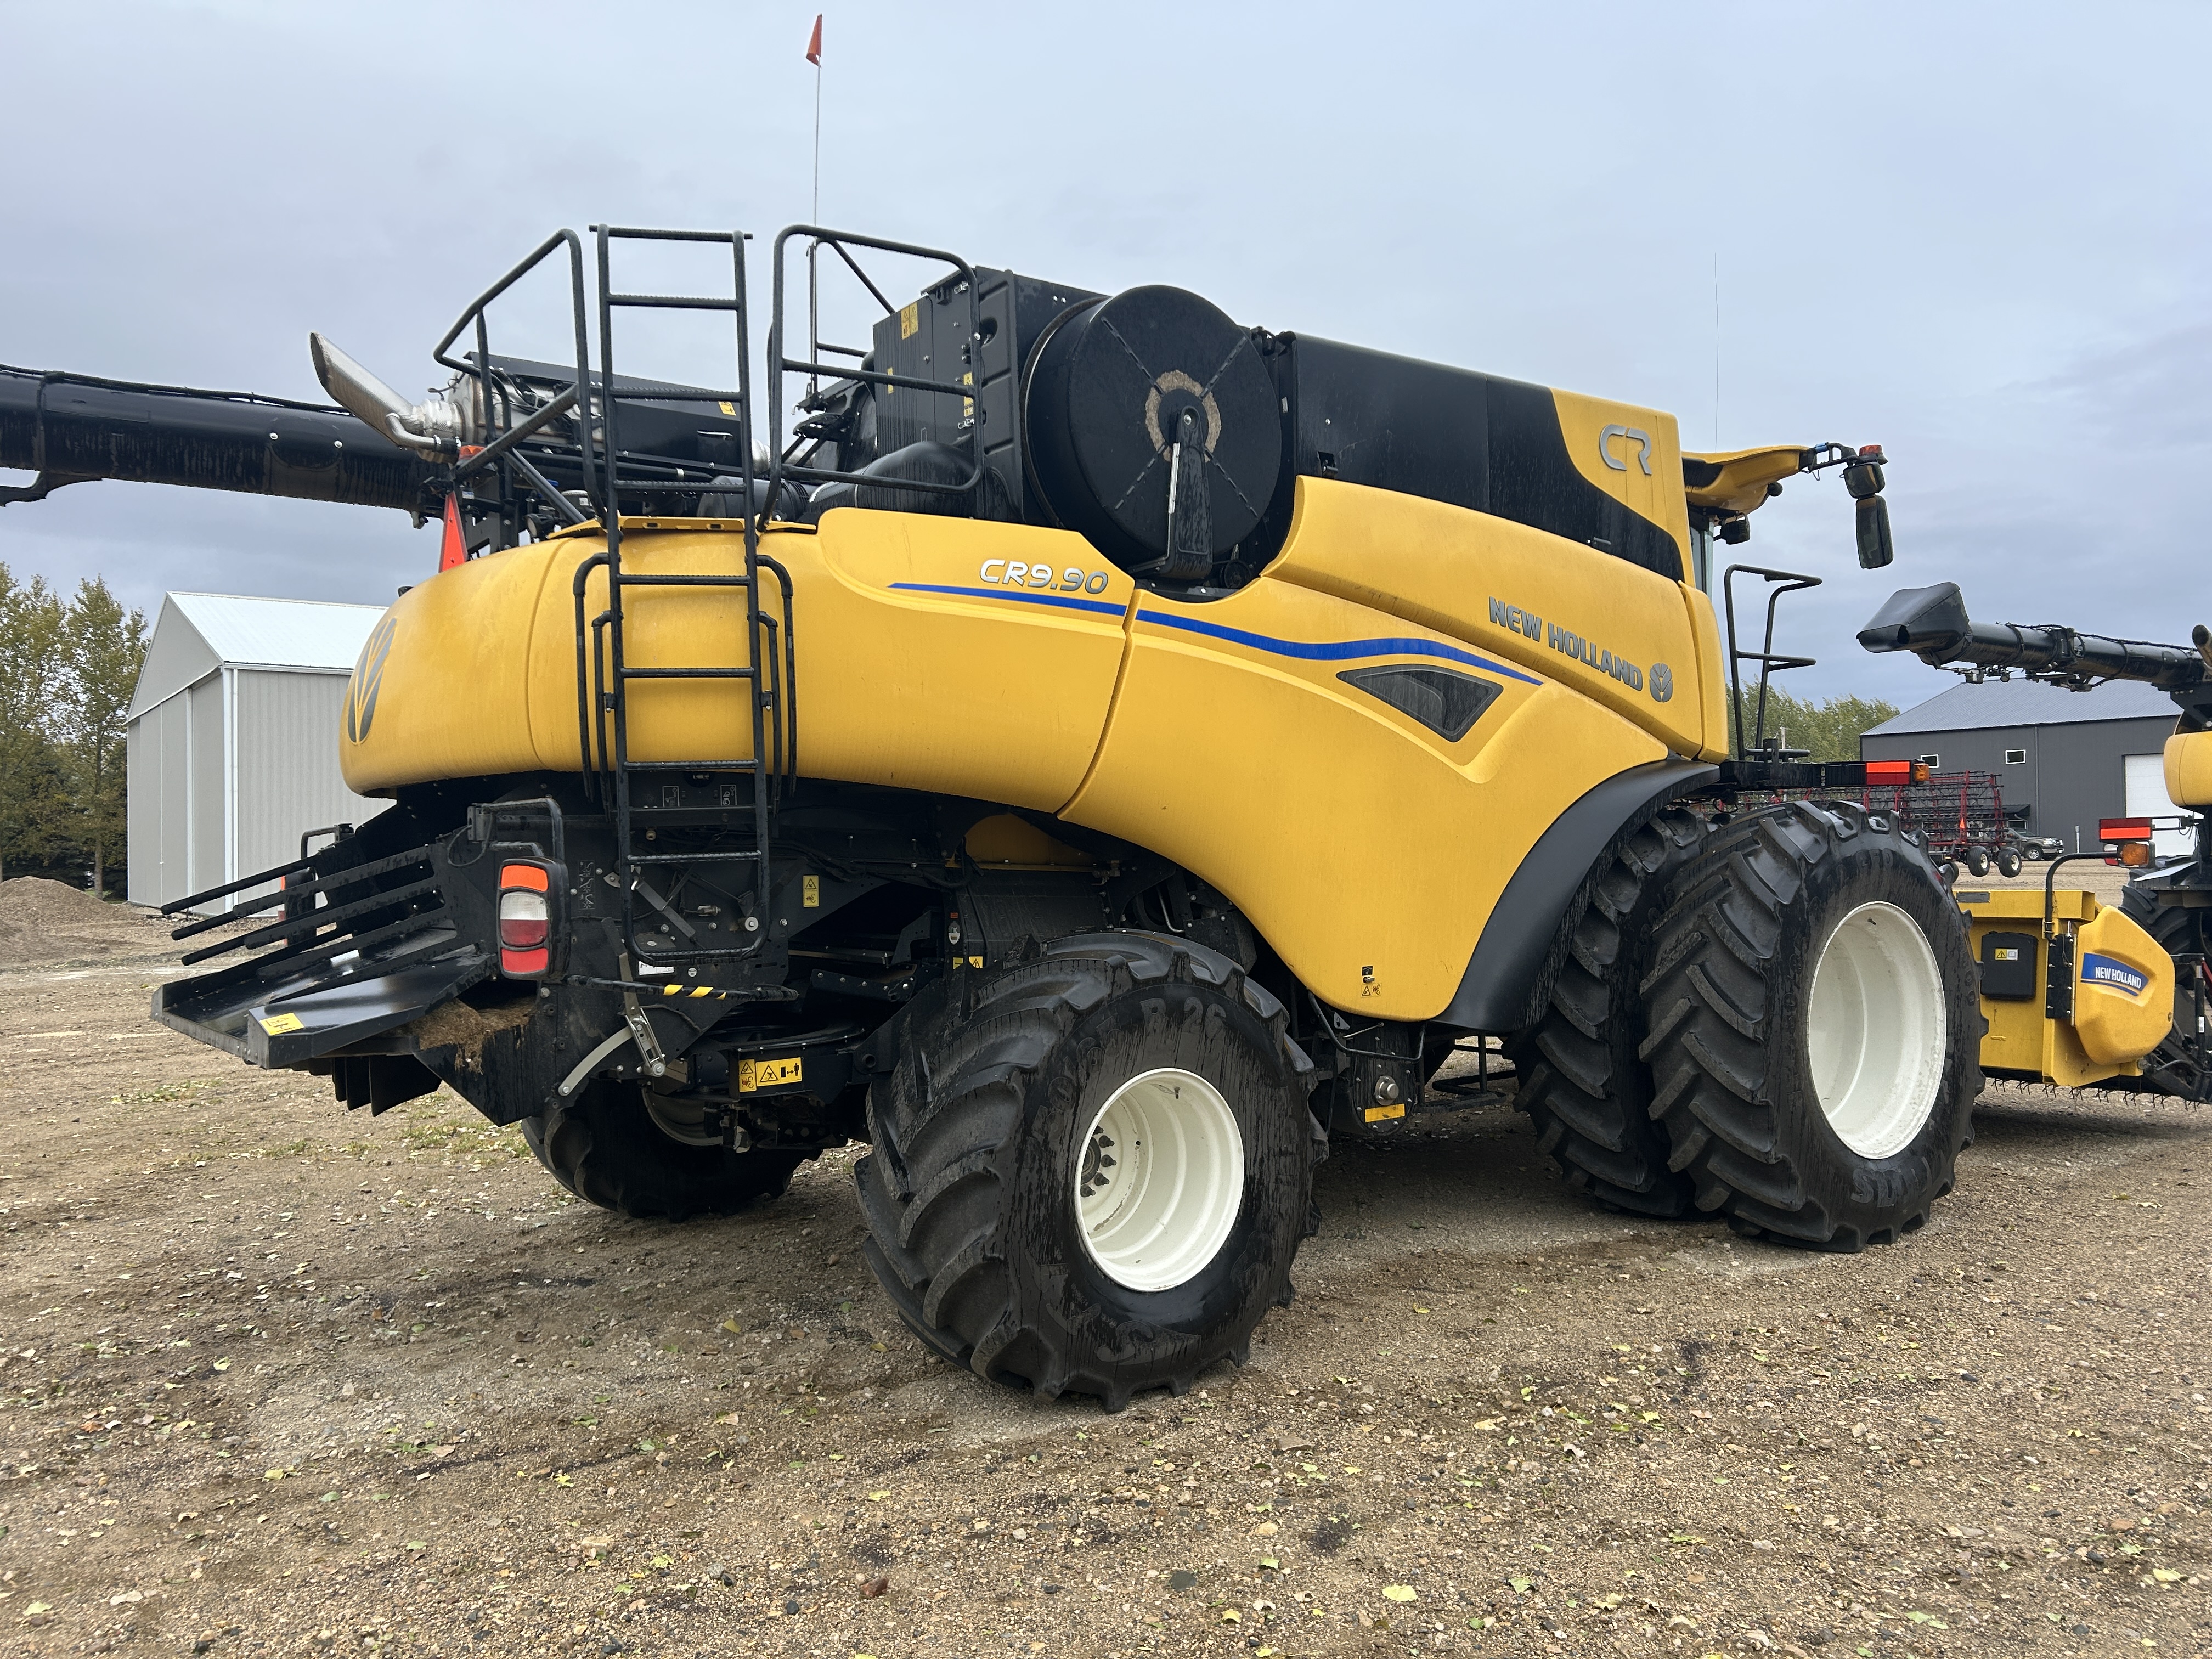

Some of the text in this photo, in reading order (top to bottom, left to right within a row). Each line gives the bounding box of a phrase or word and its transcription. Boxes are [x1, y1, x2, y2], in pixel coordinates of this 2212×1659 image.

[1599, 424, 1652, 475] CR
[980, 559, 1109, 594] CR9.90
[1489, 596, 1643, 691] NEW HOLLAND
[2095, 966, 2142, 989] NEW HOLLAND
